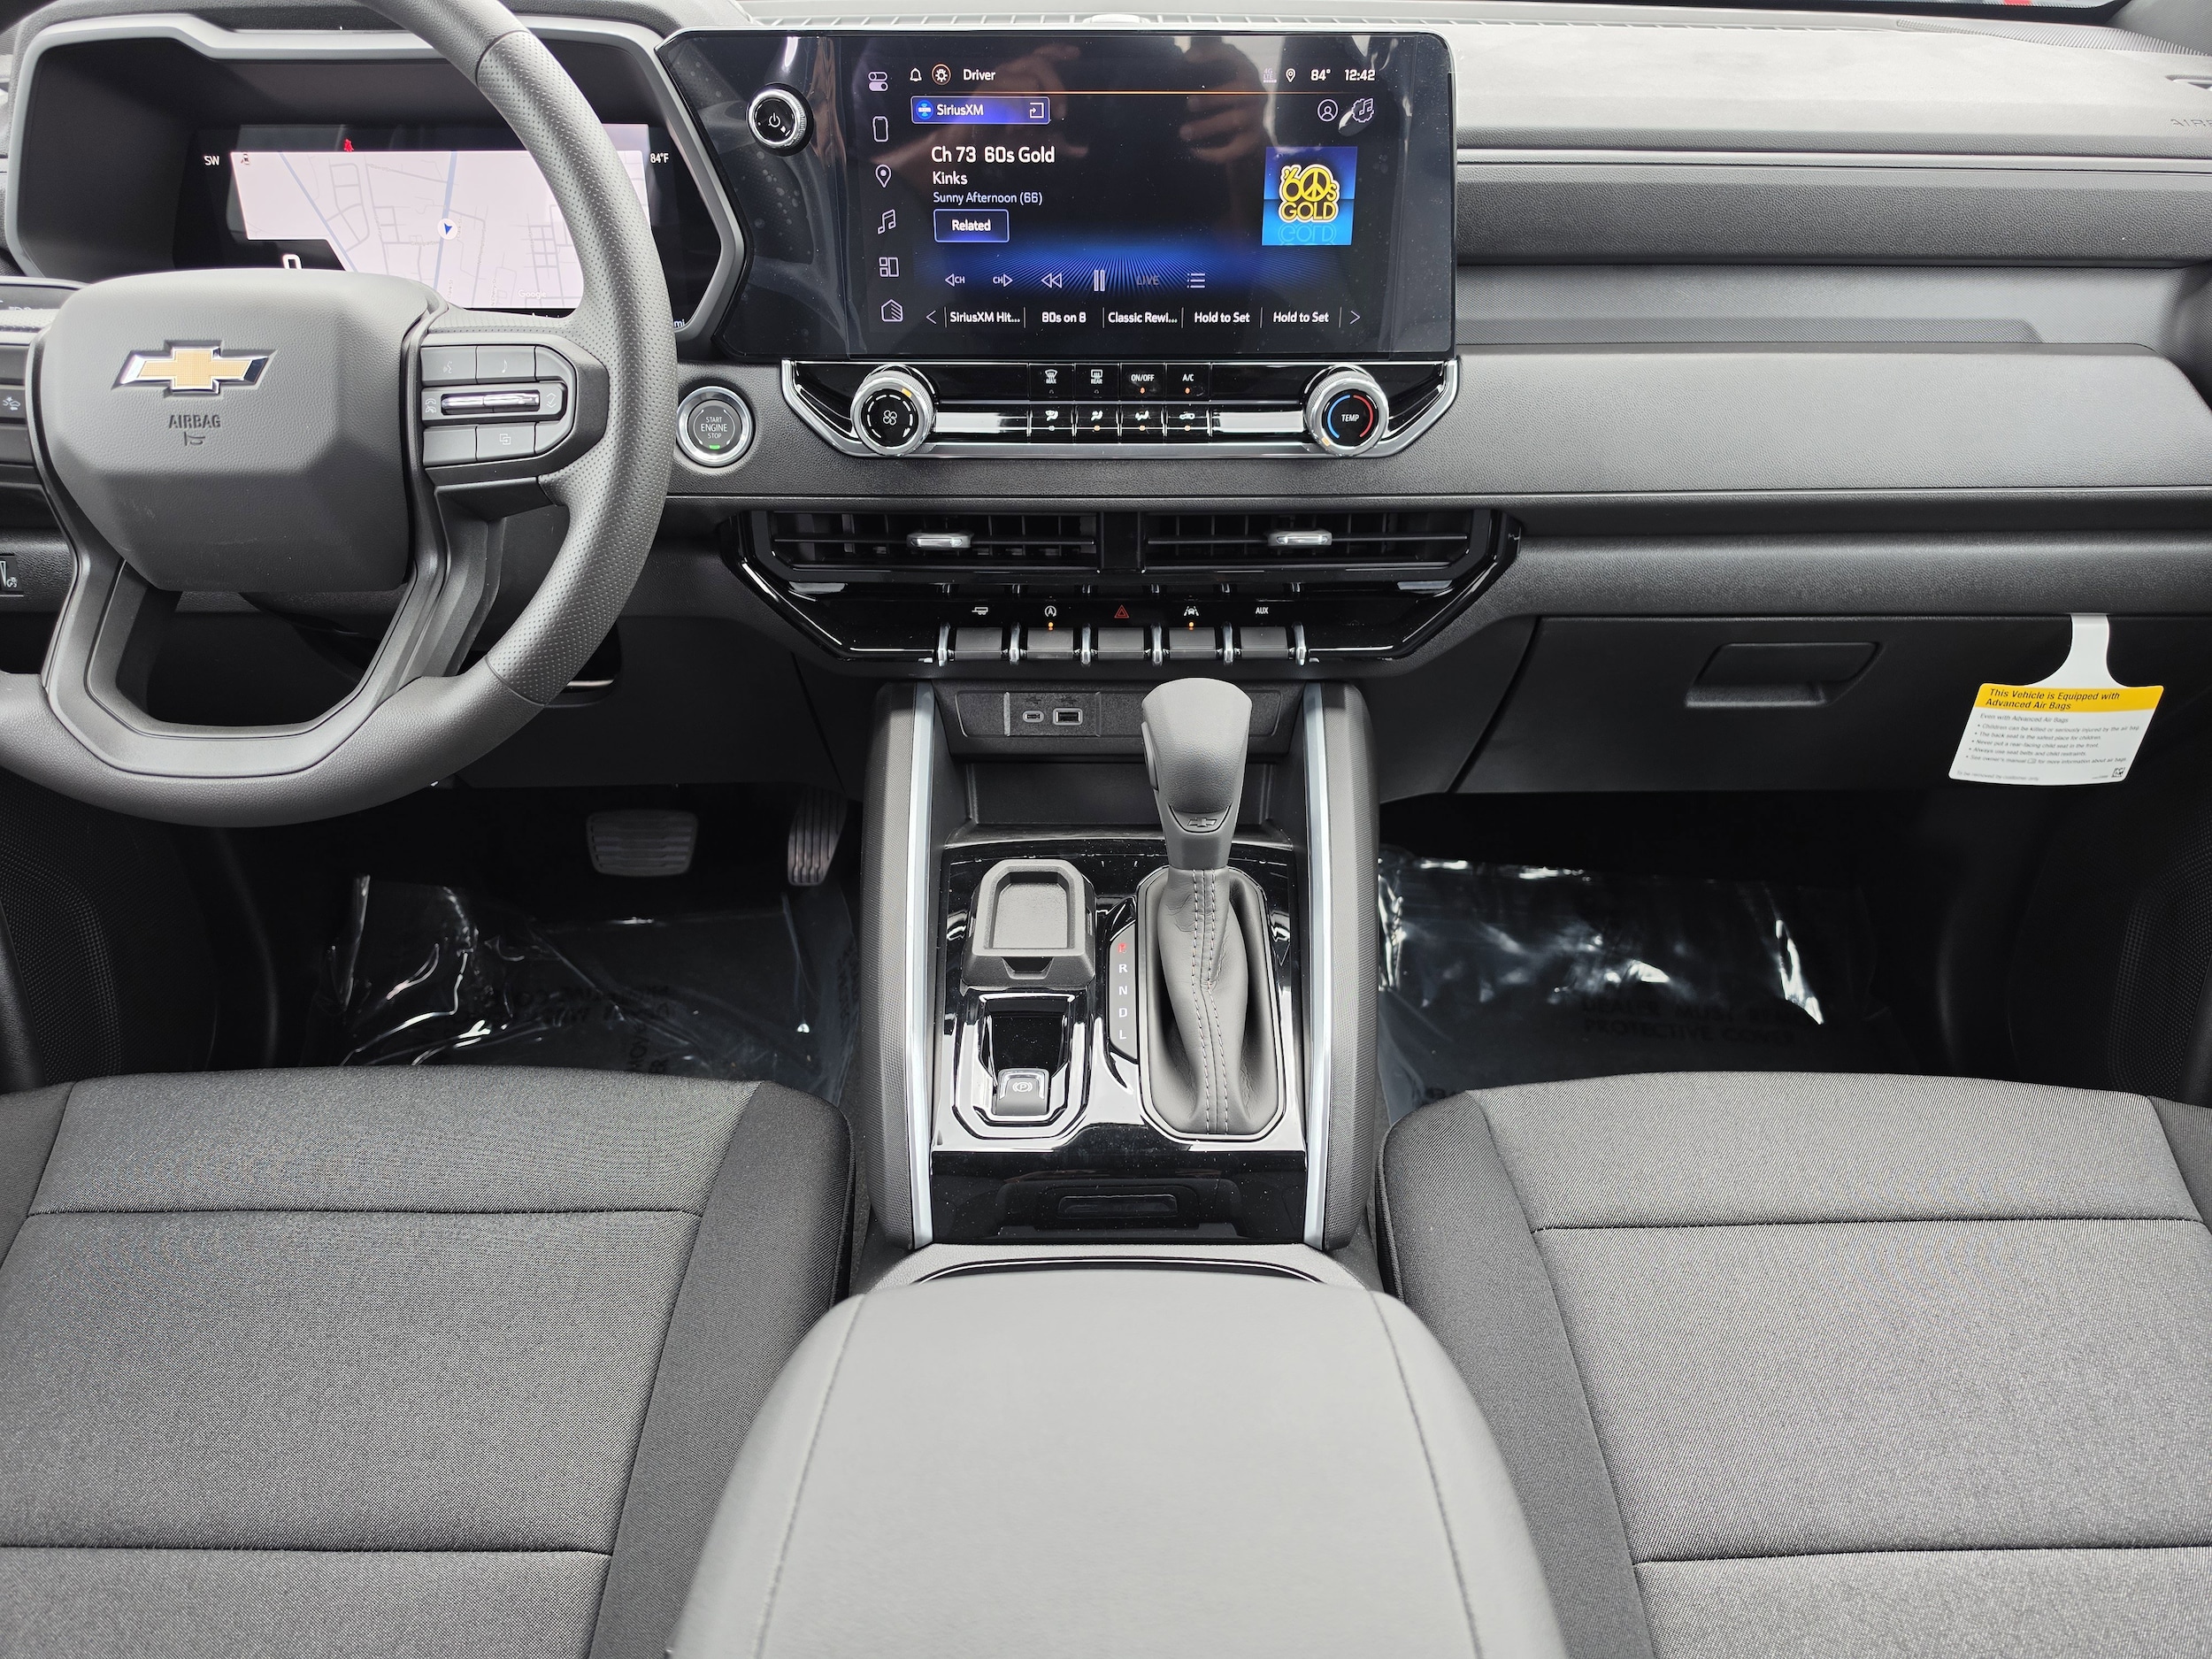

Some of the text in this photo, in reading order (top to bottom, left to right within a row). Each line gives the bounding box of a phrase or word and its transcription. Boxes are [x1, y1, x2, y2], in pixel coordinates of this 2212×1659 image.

[963, 68, 996, 81] Driver
[1310, 68, 1332, 81] 84°
[1344, 68, 1376, 81] 12:42
[936, 104, 984, 116] SiriusXM
[204, 155, 220, 166] SW
[649, 152, 670, 164] 84°F
[931, 146, 1056, 163] Ch 73 60s Gold
[932, 171, 969, 185] Kinks
[933, 191, 1044, 205] Sunny Afternoon (66)
[1280, 201, 1338, 221] GOLD
[951, 219, 992, 232] Related
[955, 275, 966, 285] CH
[992, 275, 1003, 285] CH
[518, 289, 547, 299] Google
[949, 311, 995, 324] SiriusXM
[1041, 311, 1087, 324] 80s on 8
[1108, 311, 1143, 324] Classic
[1194, 311, 1250, 324] Hold to Set
[1272, 311, 1329, 324] Hold to Set
[1130, 373, 1156, 382] ON/OFF
[1182, 373, 1194, 382] A/C
[168, 414, 221, 429] AIRBAG
[1341, 413, 1360, 422] TEMP
[700, 423, 727, 432] ENGINE
[1255, 606, 1269, 615] AUX
[1990, 688, 2009, 697] This
[2012, 690, 2045, 700] Vehicle
[2057, 692, 2099, 702] Equipped
[1985, 698, 2071, 710] Advanced Air Bags
[1118, 964, 1128, 973] R
[1118, 985, 1128, 995] N
[1118, 1007, 1128, 1018] D
[1118, 1029, 1127, 1040] L
